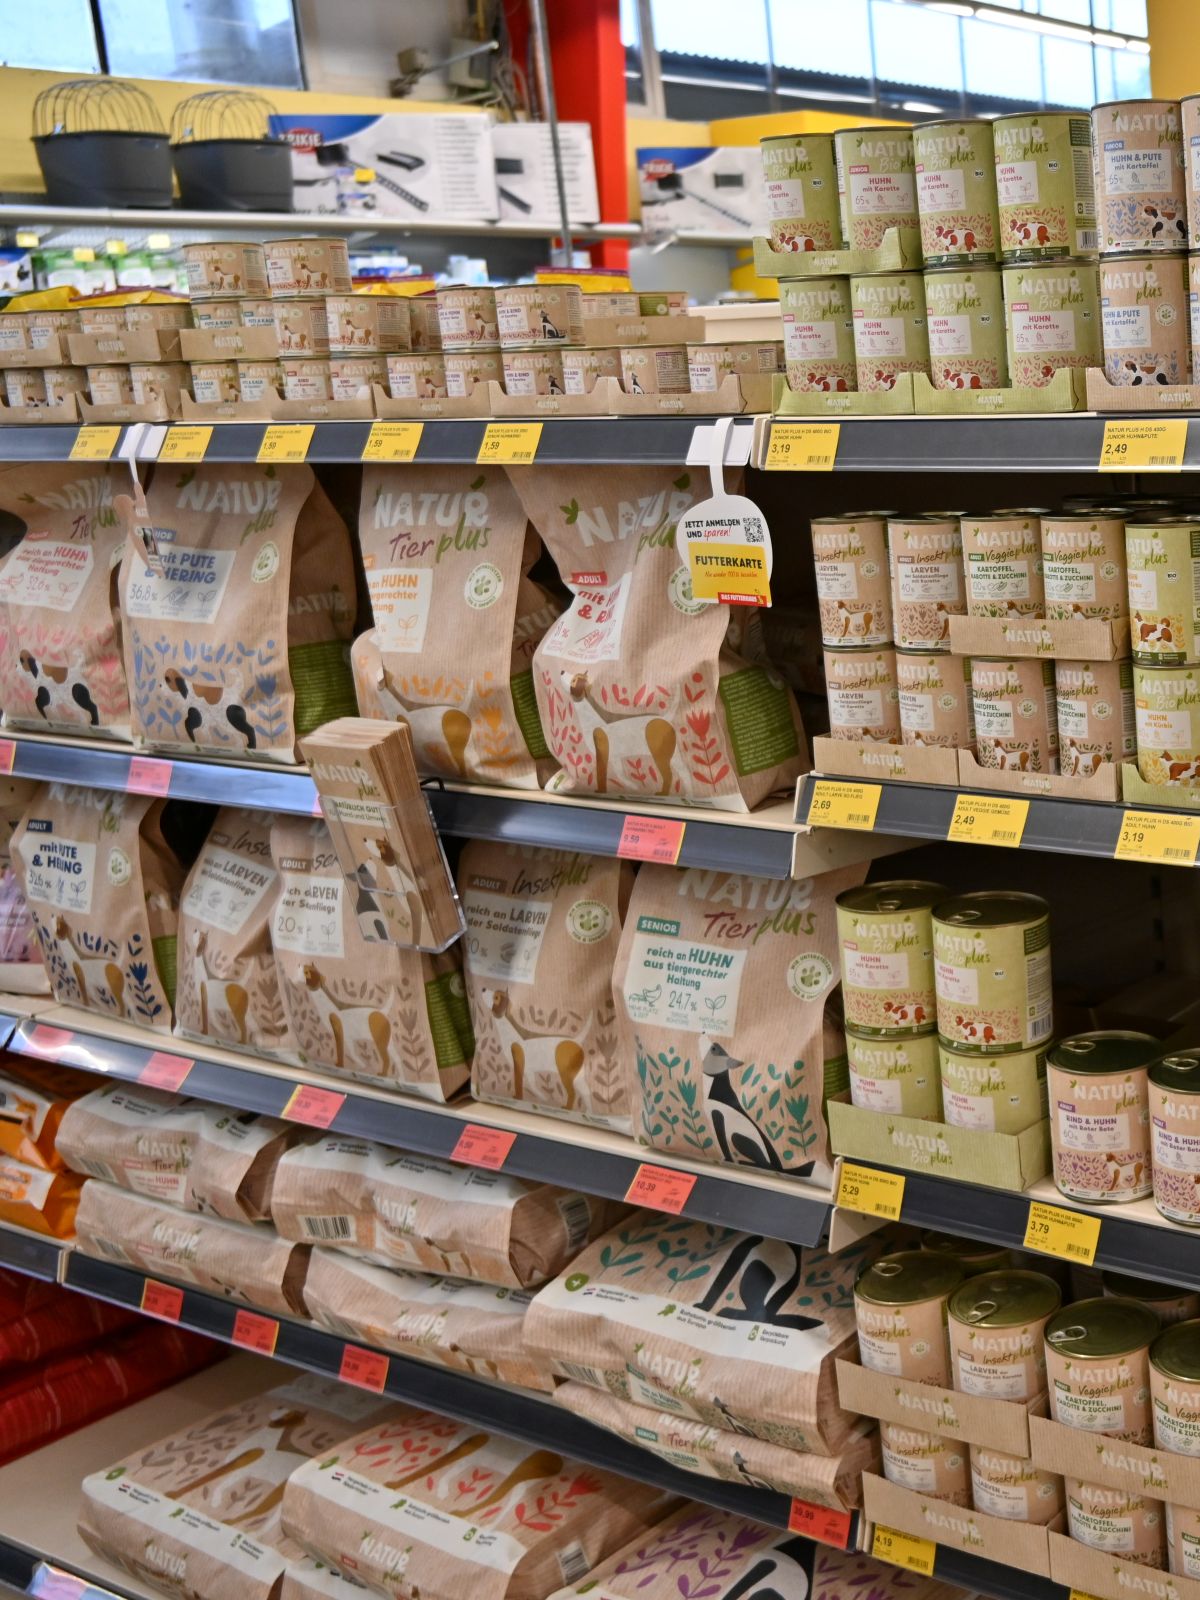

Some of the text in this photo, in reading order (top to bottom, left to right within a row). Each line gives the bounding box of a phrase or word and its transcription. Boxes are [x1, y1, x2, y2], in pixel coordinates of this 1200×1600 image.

[370, 440, 382, 448] 1,59
[485, 441, 500, 450] 1,59
[772, 444, 790, 454] 3,19
[1105, 444, 1127, 454] 2,49
[374, 492, 488, 529] NATUR
[685, 519, 740, 528] JETZT ANMELDEN
[390, 512, 492, 561] Tier plus
[703, 526, 732, 541] sparen!
[180, 553, 215, 568] PUTE
[696, 555, 762, 569] FUTTERKARTE
[813, 800, 830, 810] 2,69
[955, 815, 974, 825] 2,49
[1123, 832, 1144, 843] 3,19
[642, 920, 677, 932] SENIOR
[704, 897, 816, 945] Tier plus
[647, 947, 673, 959] reich
[689, 948, 734, 968] HUHN
[644, 960, 728, 980] aus tiergerechter
[667, 975, 700, 990] Haltung
[637, 1181, 656, 1192] 10,39
[842, 1184, 859, 1196] 5,29
[1030, 1221, 1049, 1234] 3,79
[1065, 1396, 1107, 1406] KARTOFFEL,
[1088, 1405, 1121, 1413] ZUCCHINI
[876, 1535, 892, 1547] 4,19
